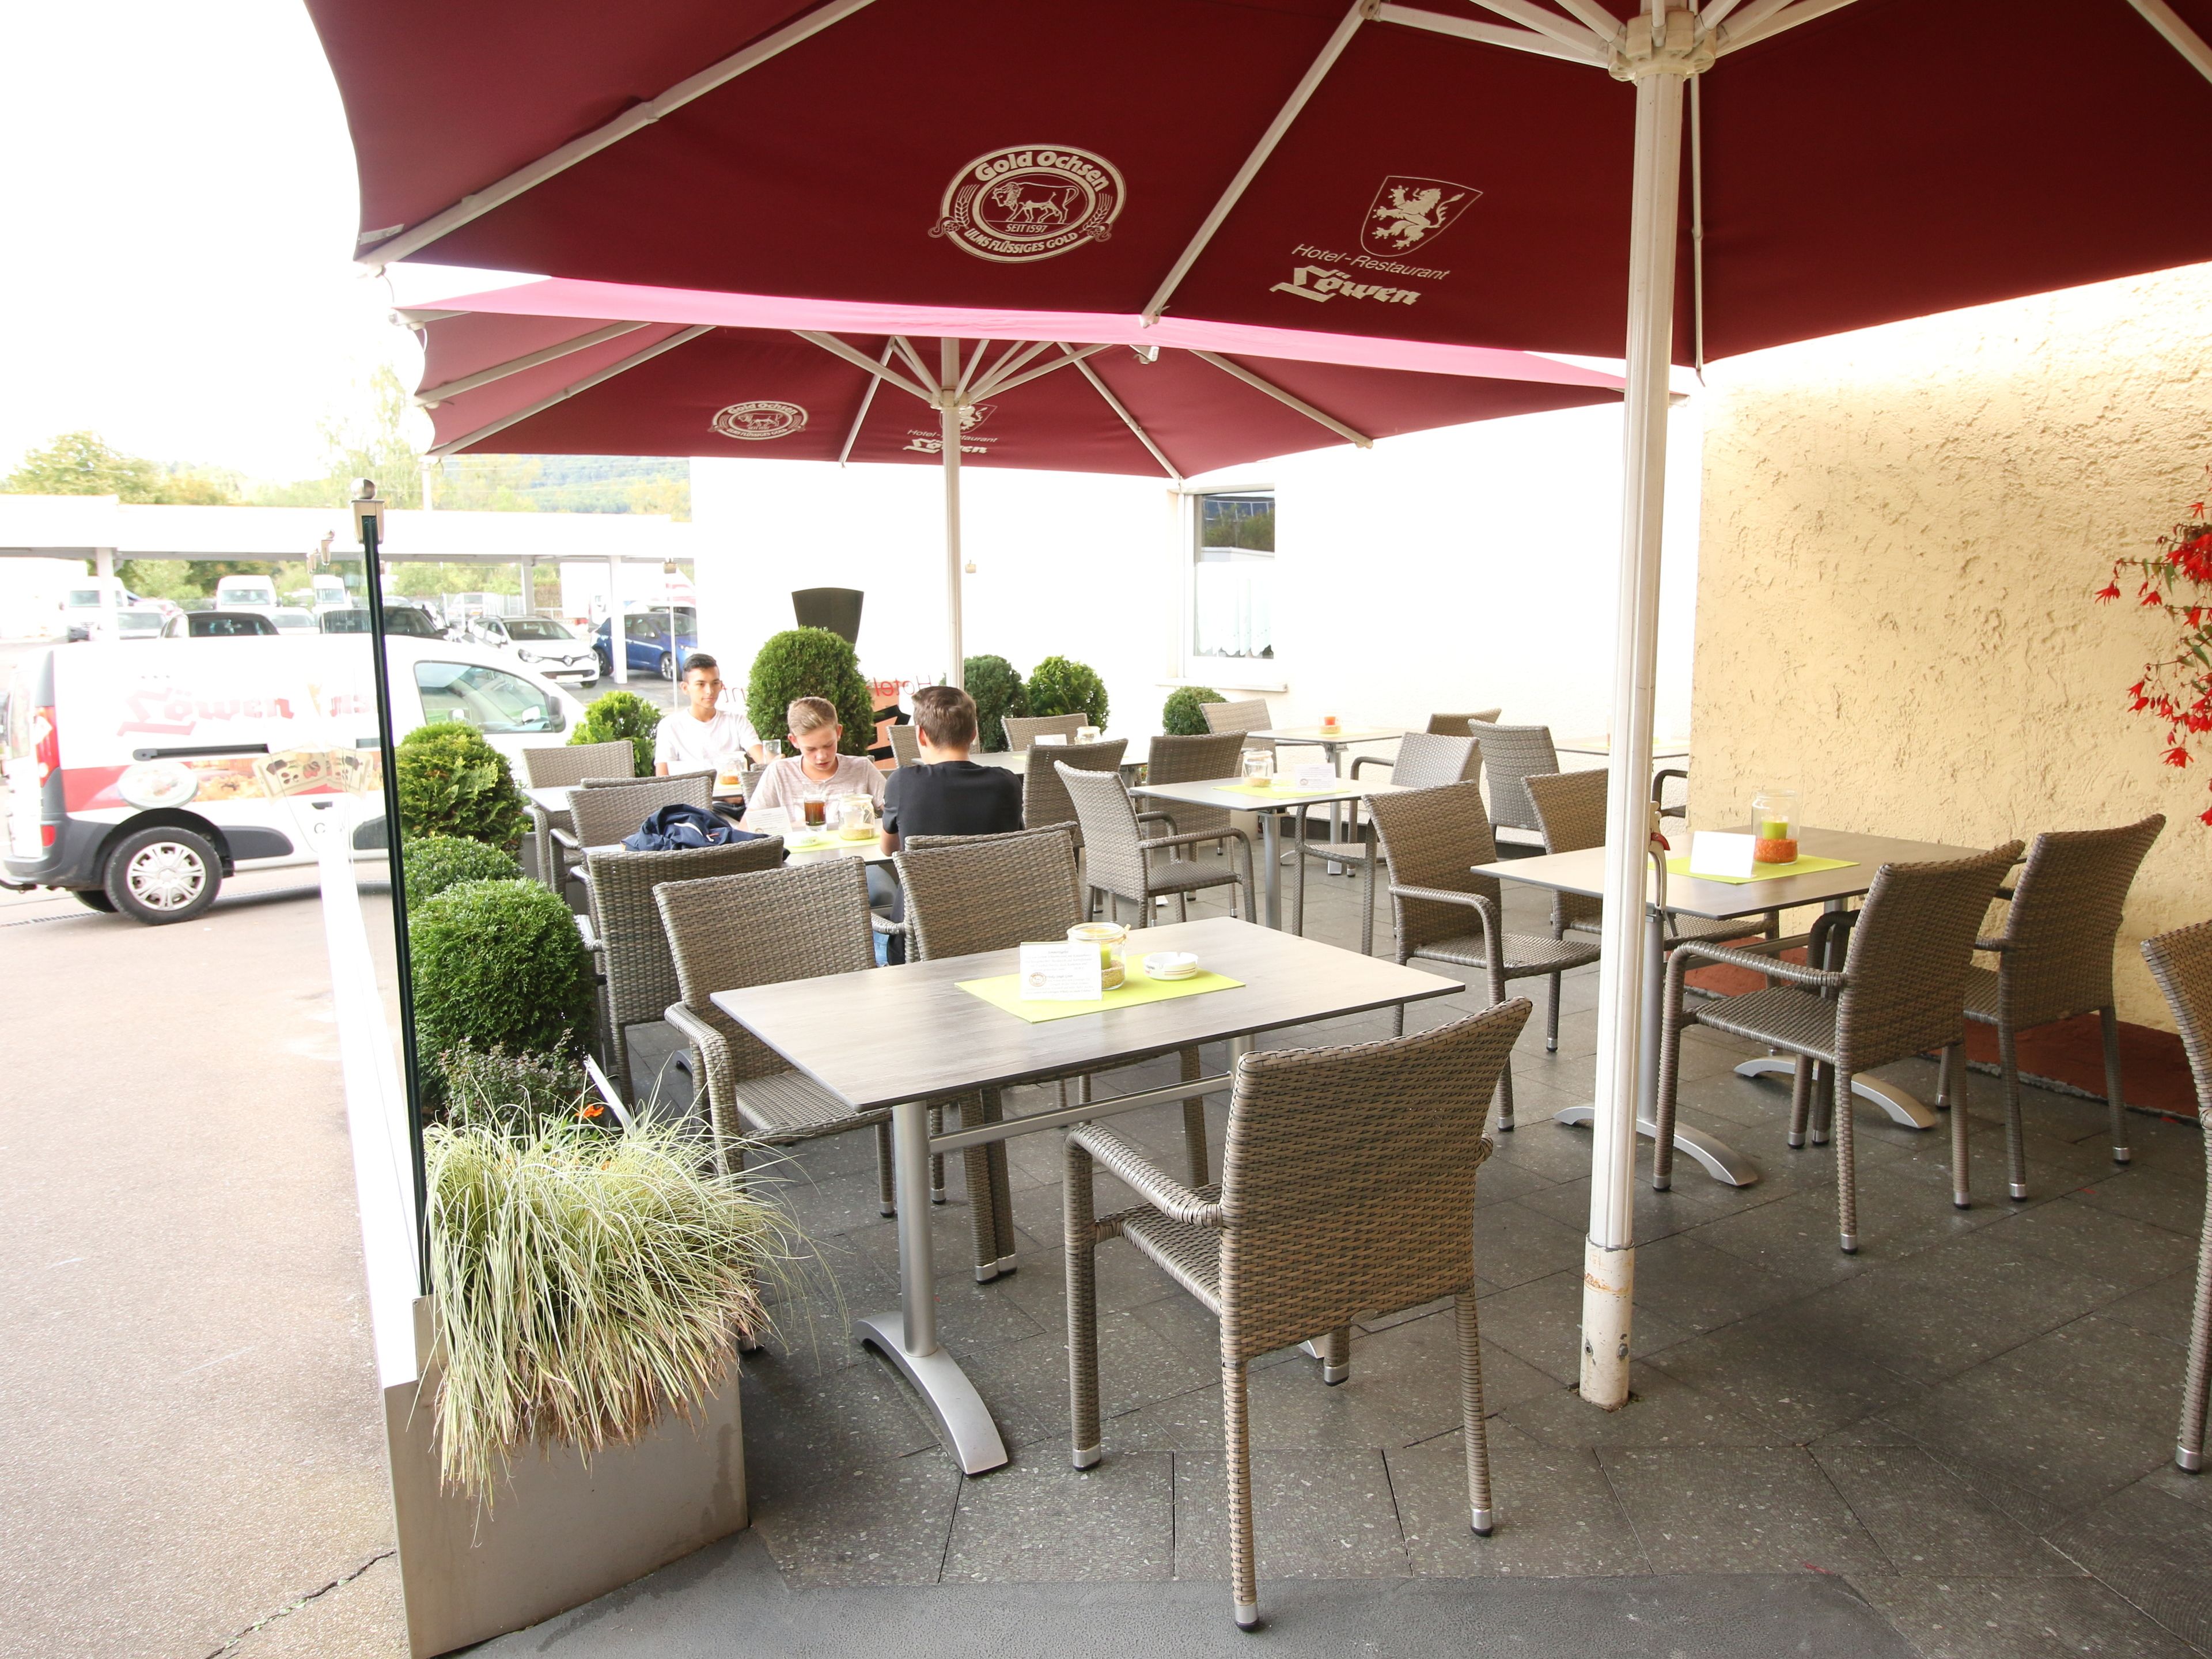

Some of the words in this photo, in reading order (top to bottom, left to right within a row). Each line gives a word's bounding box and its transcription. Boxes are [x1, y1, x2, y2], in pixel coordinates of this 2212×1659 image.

[975, 151, 1033, 182] Gold
[1037, 151, 1109, 192] Ochsen
[963, 228, 991, 248] ULMS
[988, 238, 1045, 253] FLÜSSIGES
[1046, 232, 1078, 249] GOLD
[1005, 223, 1026, 233] SEIT
[1025, 224, 1048, 233] 1597
[1269, 265, 1421, 305] Löwen
[727, 403, 757, 414] Gold
[757, 403, 798, 415] Ochsen
[903, 438, 987, 454] Löen
[116, 687, 294, 737] Löwen
